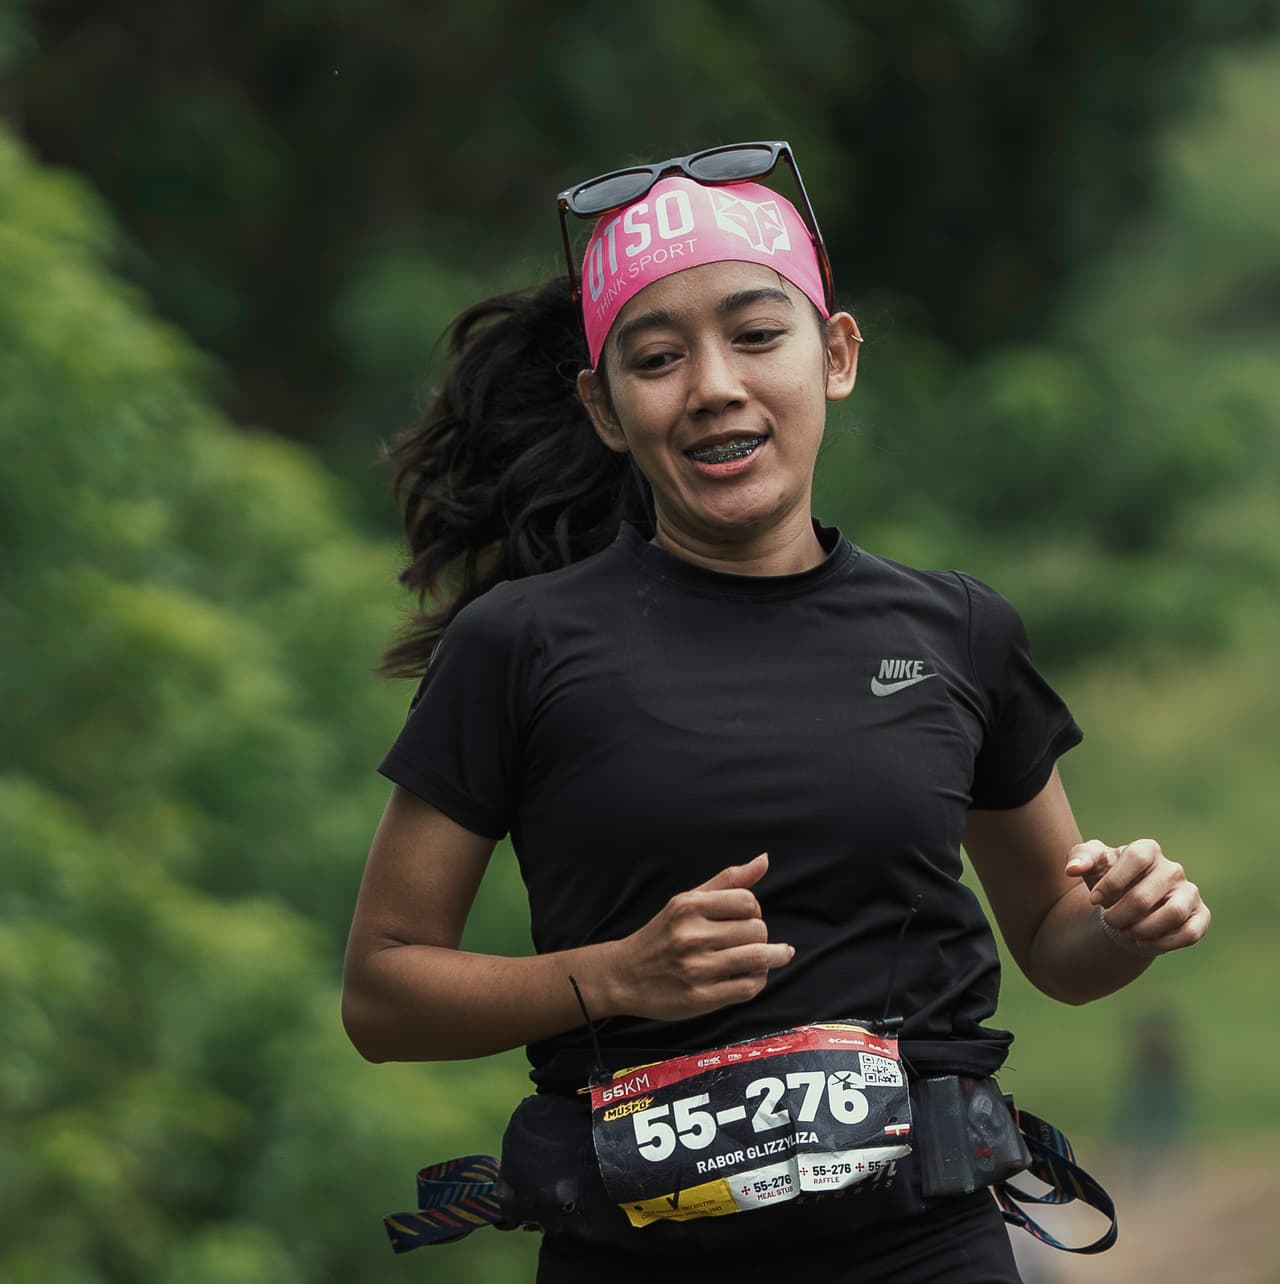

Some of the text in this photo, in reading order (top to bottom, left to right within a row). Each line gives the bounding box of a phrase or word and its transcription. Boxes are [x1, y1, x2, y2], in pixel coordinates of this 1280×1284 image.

[589, 189, 695, 302] OTSO
[596, 239, 697, 318] THINK SPORT
[878, 659, 924, 679] NIKE
[602, 1073, 650, 1101] 55KM
[632, 1071, 870, 1162] 55-276
[696, 1151, 745, 1174] RABOR
[812, 1163, 852, 1177] 55-276
[753, 1174, 792, 1193] 55-276
[813, 1177, 840, 1185] RAFFLE
